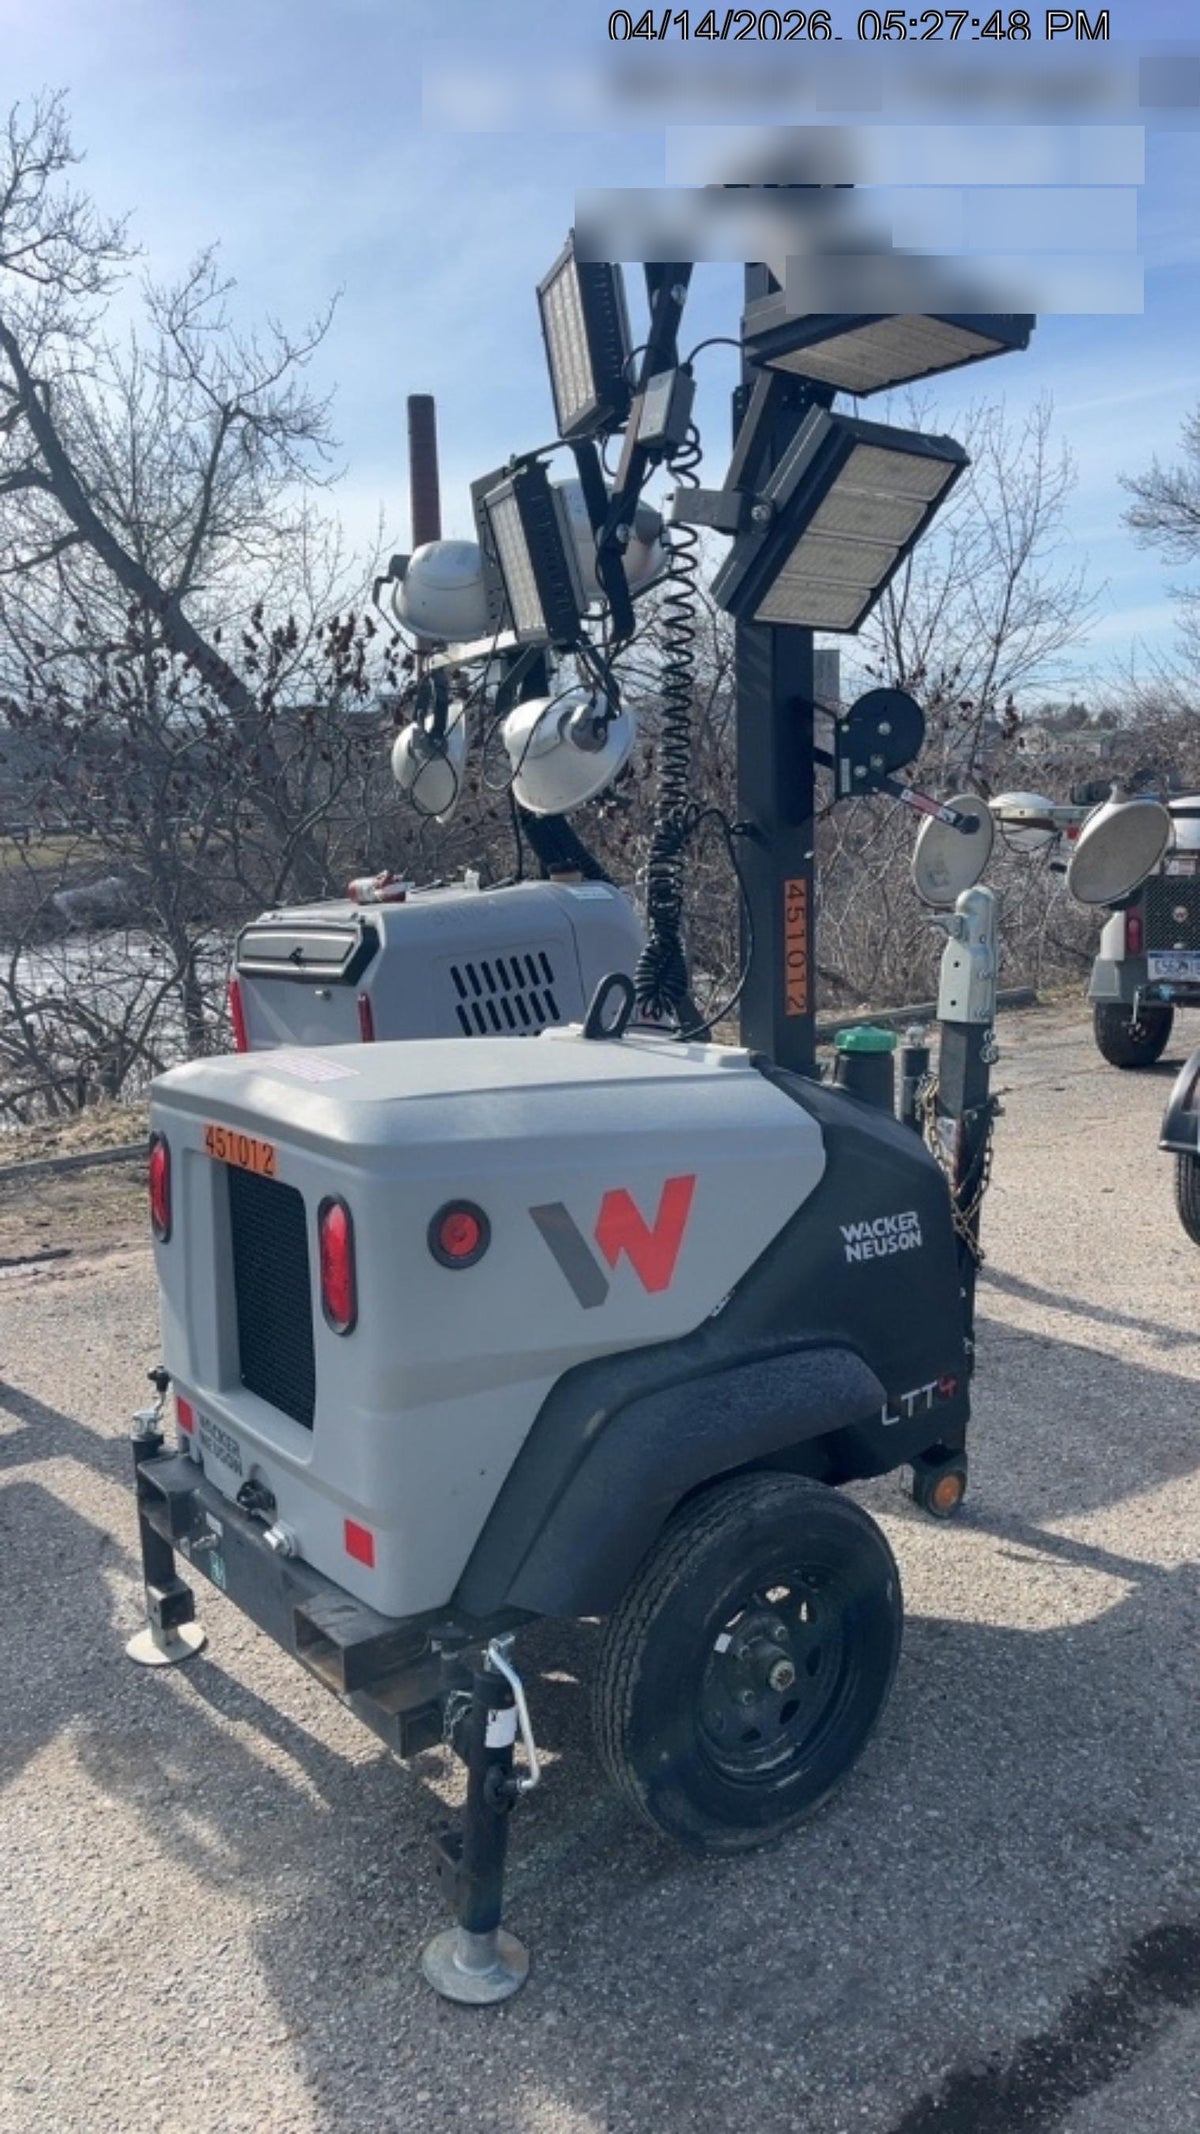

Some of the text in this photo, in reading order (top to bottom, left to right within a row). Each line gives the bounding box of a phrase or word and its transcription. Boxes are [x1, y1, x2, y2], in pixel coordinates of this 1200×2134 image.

[786, 883, 806, 1009] 451012
[206, 1124, 273, 1175] 451012
[839, 1210, 920, 1243] WACKER
[844, 1230, 923, 1263] NEUSON
